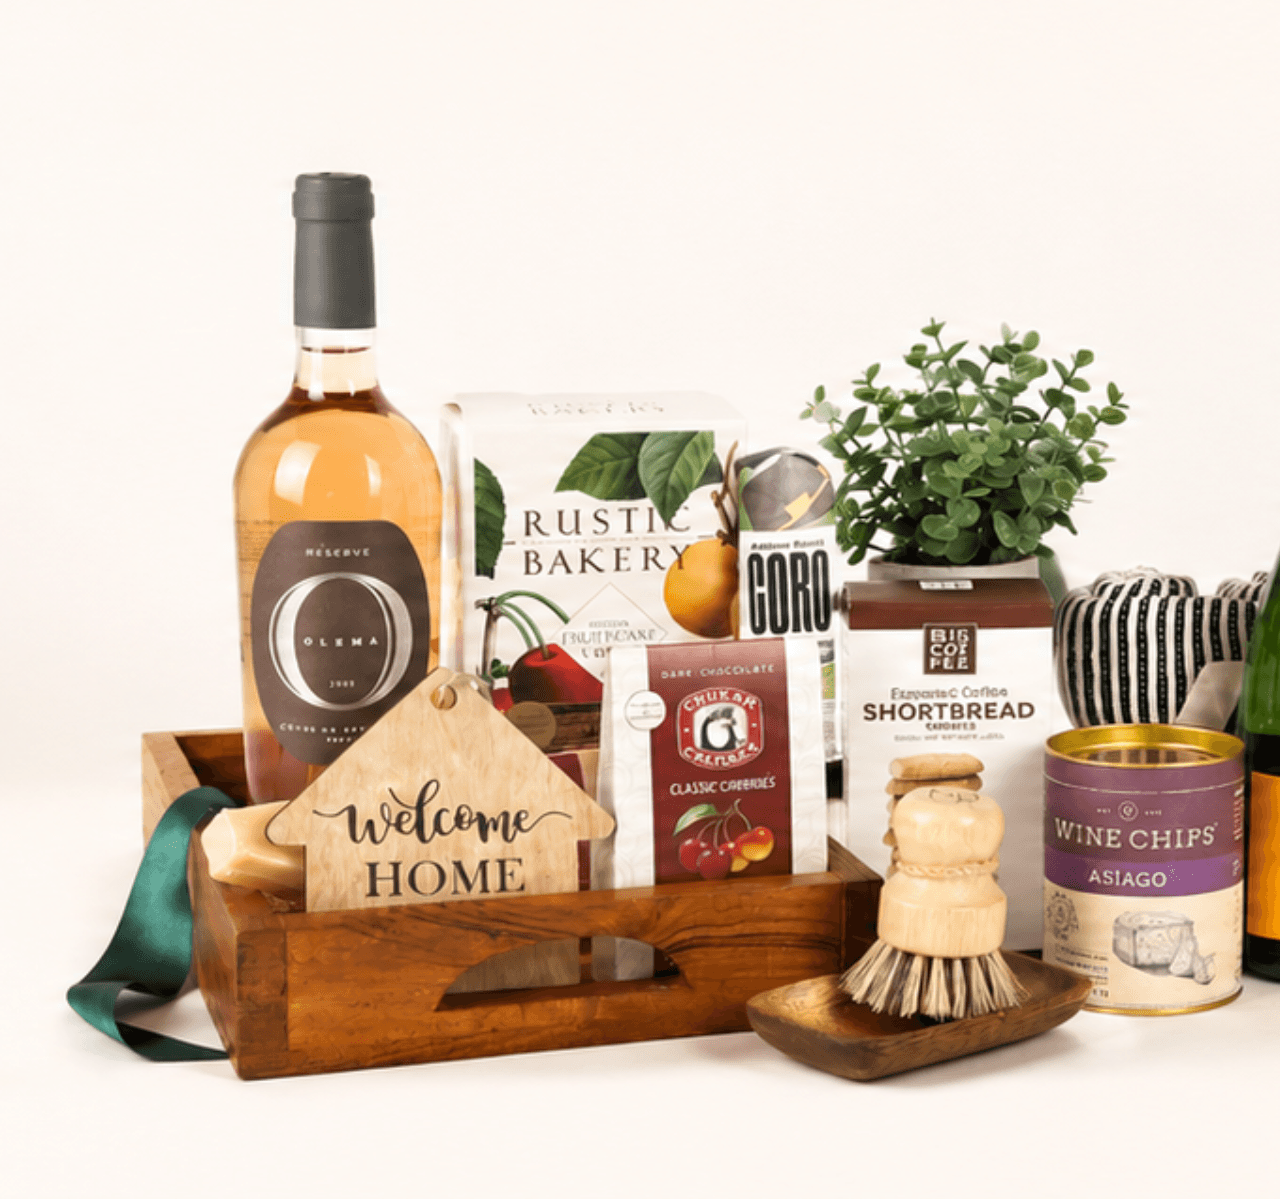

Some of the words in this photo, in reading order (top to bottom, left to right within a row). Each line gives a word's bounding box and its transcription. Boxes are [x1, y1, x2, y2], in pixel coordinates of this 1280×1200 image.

[523, 505, 691, 538] RUSTIC
[523, 544, 691, 576] BAKERY
[303, 636, 378, 647] OLEMA
[930, 628, 970, 643] BIG
[863, 701, 1035, 721] SHORTBREAD
[1055, 817, 1122, 849] WINE
[1129, 825, 1215, 850] CHIPS
[365, 858, 525, 897] HOME
[1088, 870, 1168, 888] ASIAGO
